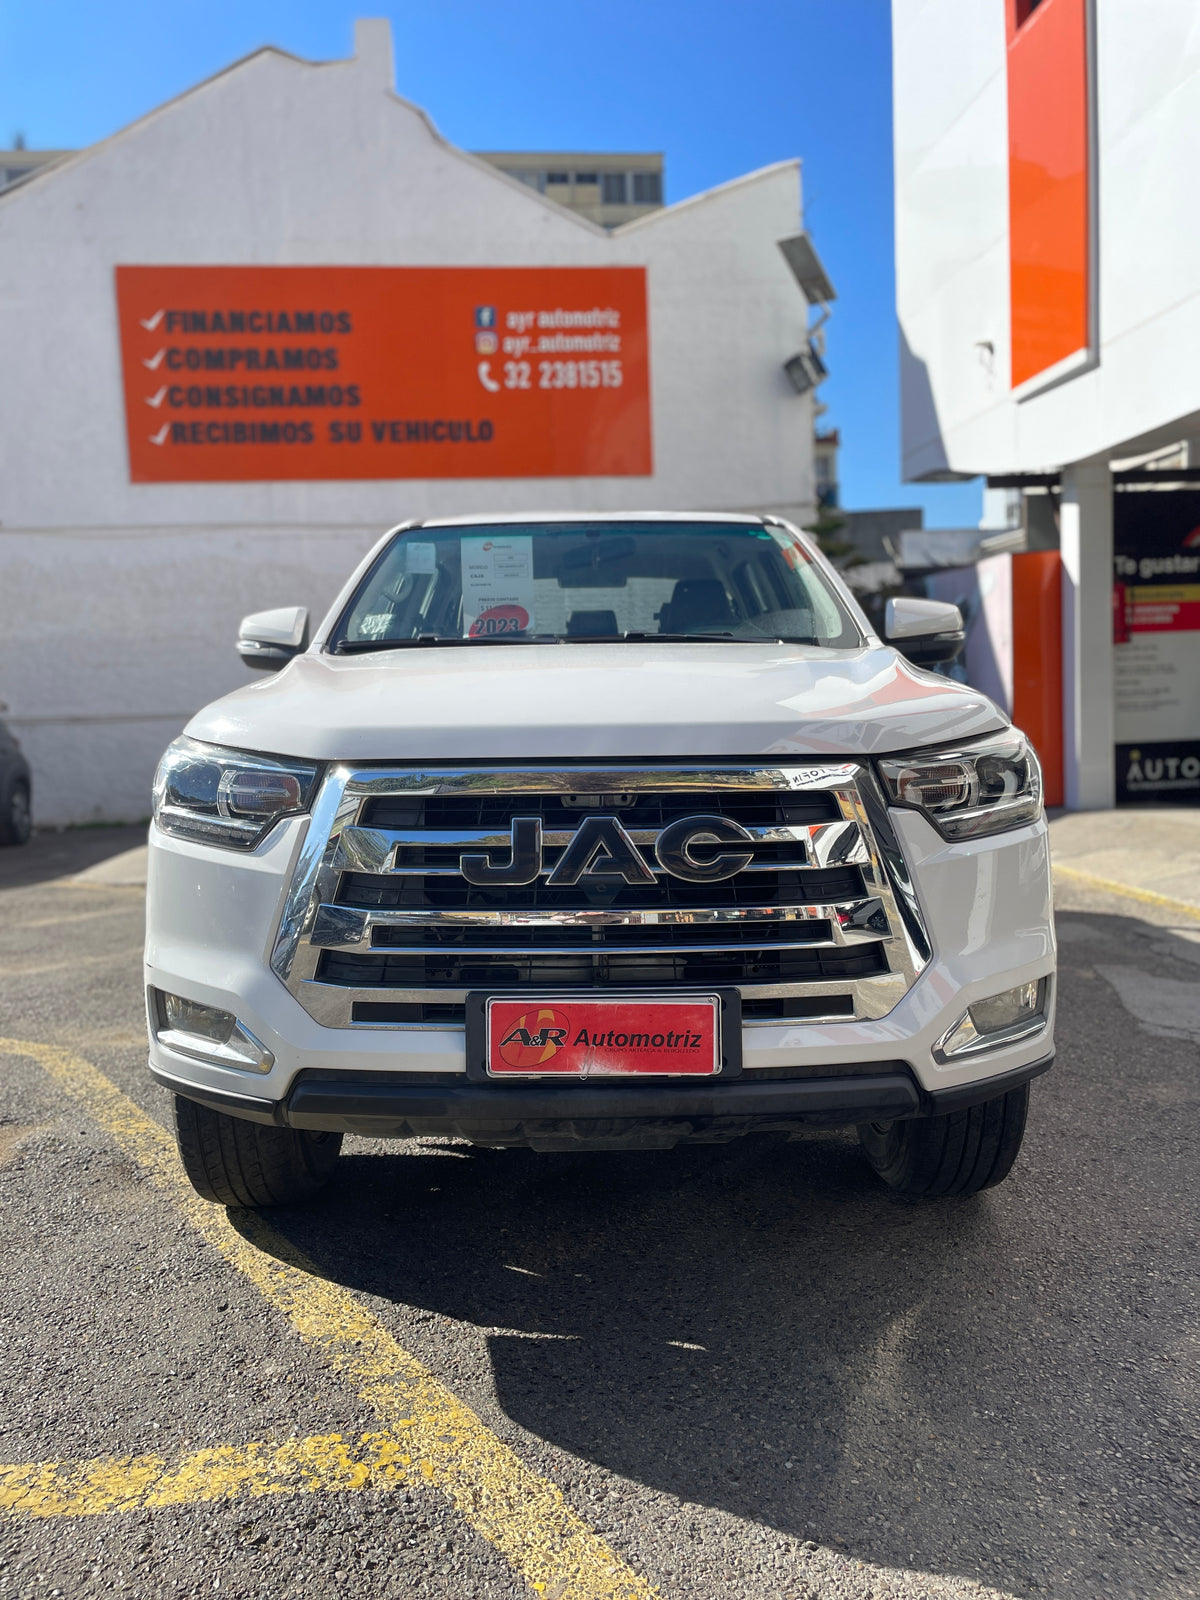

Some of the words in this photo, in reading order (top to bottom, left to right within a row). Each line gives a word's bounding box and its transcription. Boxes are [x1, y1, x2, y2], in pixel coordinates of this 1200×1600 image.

[165, 310, 352, 334] FINANCIAMOS
[505, 310, 535, 333] ayr
[537, 308, 620, 329] automotriz
[166, 347, 339, 371] COMPRAMOS
[503, 361, 532, 389] 32
[539, 360, 623, 389] 2381515
[168, 384, 362, 407] CONSIGNAMOS
[171, 420, 315, 444] RECIBIMOS
[328, 420, 362, 443] SU
[371, 419, 494, 444] VEHICULO
[1113, 555, 1137, 575] Te
[475, 617, 520, 635] 2023
[460, 815, 754, 886] JAC
[498, 1028, 568, 1048] A&R
[573, 1029, 702, 1048] Automotriz
